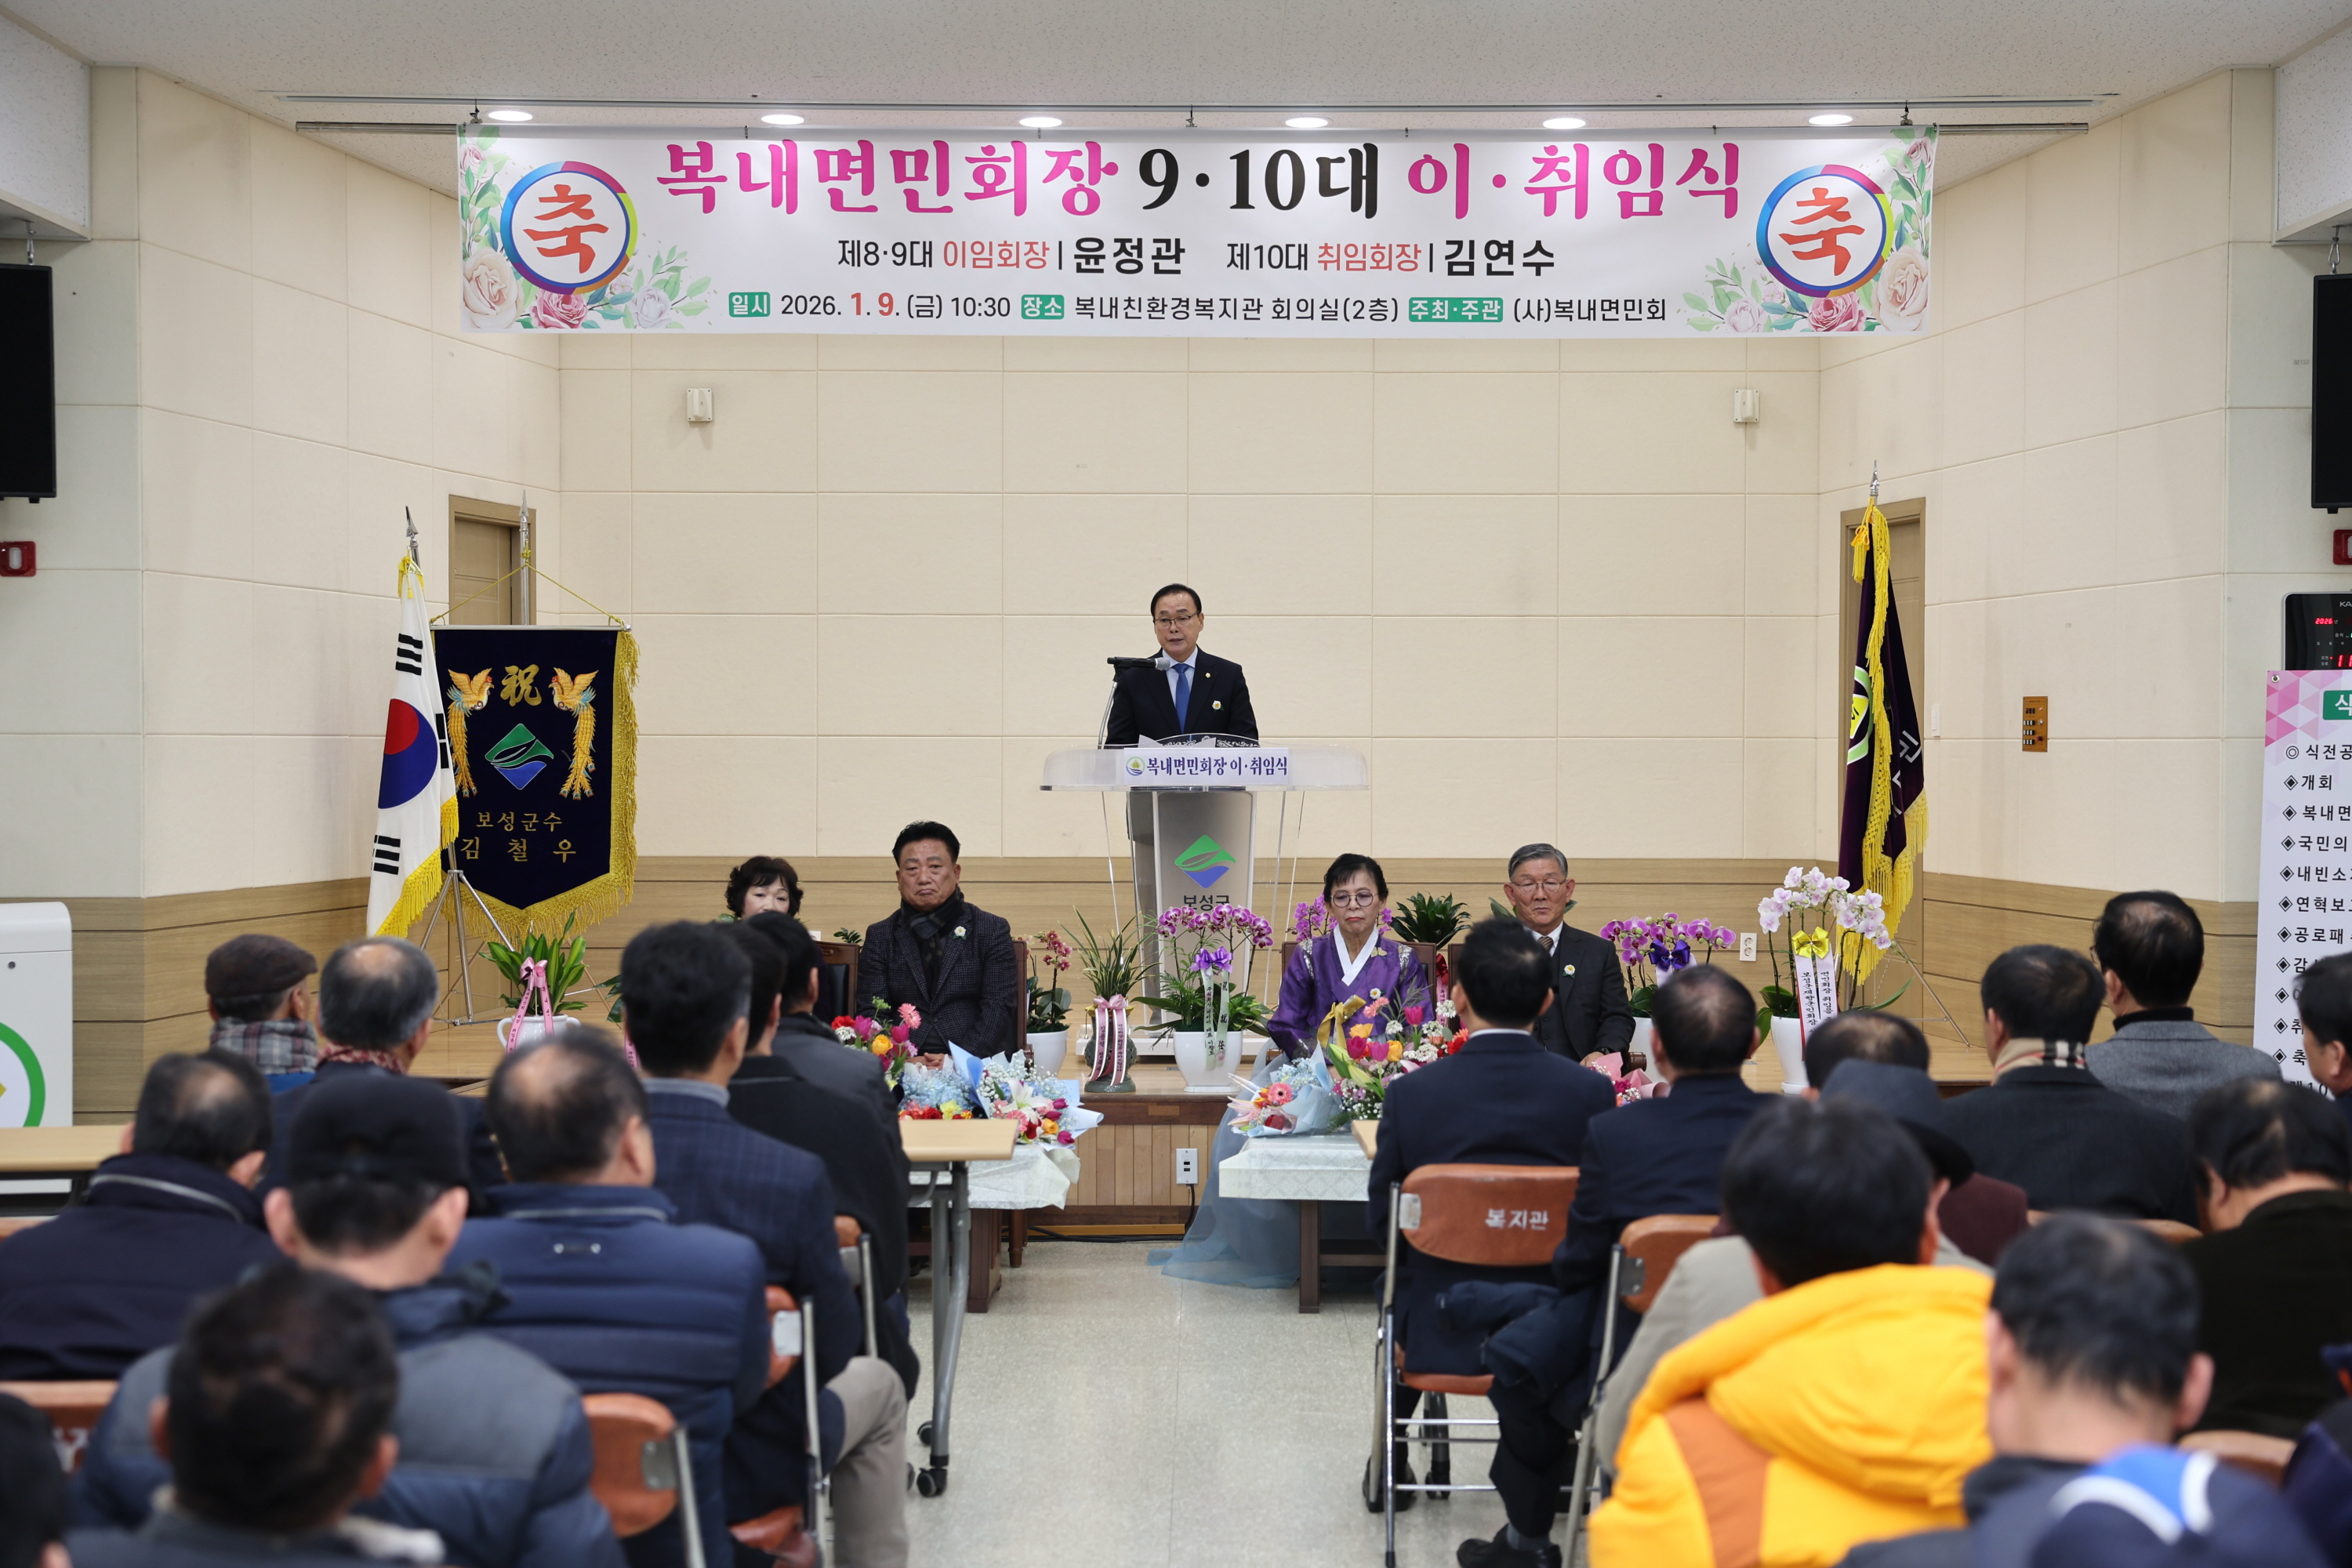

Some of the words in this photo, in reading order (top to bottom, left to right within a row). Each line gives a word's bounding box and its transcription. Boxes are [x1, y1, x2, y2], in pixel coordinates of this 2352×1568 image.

[657, 140, 1119, 217] 복내면민회장
[1139, 143, 1378, 219] 9·10대
[1406, 143, 1739, 219] 이·취임식
[523, 184, 609, 274] 축
[1778, 187, 1866, 276] 축
[838, 239, 933, 268] 제8·9대
[943, 240, 1050, 270] 이임회장
[1074, 238, 1186, 275] 윤정관
[1226, 242, 1308, 271] 제10대
[1317, 242, 1422, 273] 취임회장
[1444, 239, 1555, 277] 김연수
[732, 296, 768, 315] 일시
[781, 294, 842, 316] 2026.
[951, 296, 1011, 318] 10:30
[1024, 297, 1062, 317] 장소
[1075, 296, 1264, 321] 복내친환경복지관
[1271, 297, 1399, 322] 회의실(2층)
[1411, 299, 1501, 321] 주최·주관
[1513, 298, 1666, 323] (사)복내면민회
[500, 664, 542, 706] 祝
[2306, 744, 2352, 760] 식전공
[1146, 757, 1227, 776] 복내면민회장
[2301, 775, 2332, 790] 개회
[476, 811, 563, 833] 보성군수
[2302, 805, 2351, 822] 복내면
[2298, 836, 2352, 852] 국민의
[2297, 866, 2352, 882] 내빈소
[2294, 927, 2343, 944] 공로패
